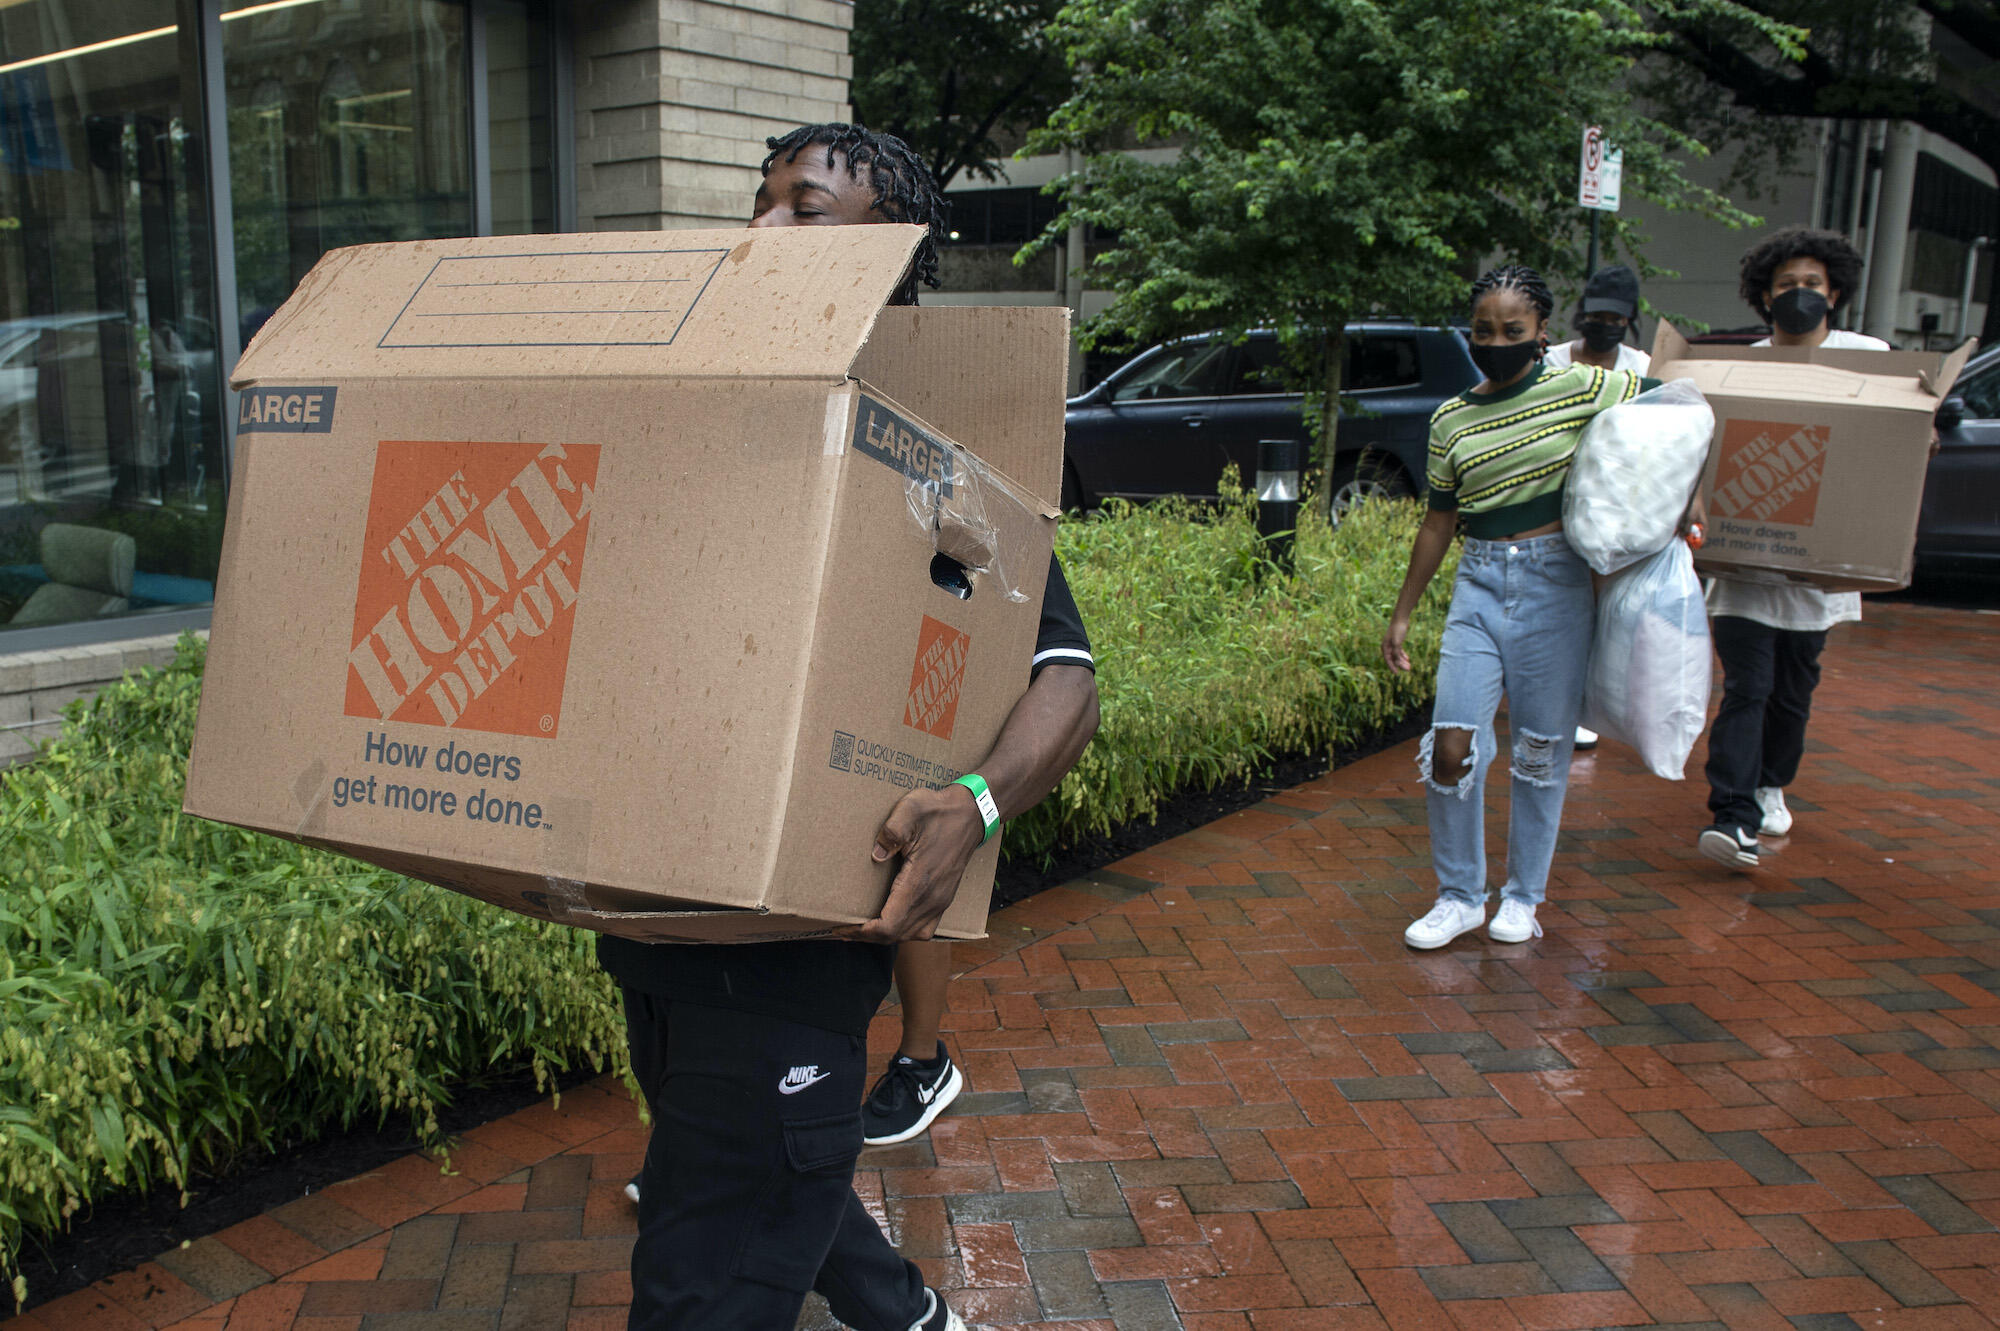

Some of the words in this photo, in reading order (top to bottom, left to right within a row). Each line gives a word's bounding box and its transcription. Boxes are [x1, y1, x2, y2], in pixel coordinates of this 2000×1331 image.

[240, 394, 323, 425] LARGE
[866, 409, 943, 482] LARGE
[1728, 431, 1776, 470] THE
[1710, 424, 1829, 517] HOME
[1752, 462, 1822, 521] DEPOT
[381, 469, 481, 581] THE
[1720, 521, 1752, 536] How
[1755, 526, 1797, 540] doers
[1729, 540, 1766, 552] more
[349, 443, 595, 721] HOME
[426, 551, 578, 727] DEPOT
[920, 632, 946, 673] THE
[907, 631, 970, 728] HOME
[925, 671, 961, 732] DEPOT
[364, 732, 428, 768] How
[435, 741, 521, 781] doers
[854, 758, 888, 782] SUPPLY
[888, 769, 914, 790] NEEDS
[858, 739, 896, 763] QUICKLY
[895, 751, 932, 776] ESTIMATE
[932, 763, 954, 783] YOUR
[333, 775, 376, 807] get
[384, 781, 457, 816] more
[786, 1065, 819, 1084] NIKE
